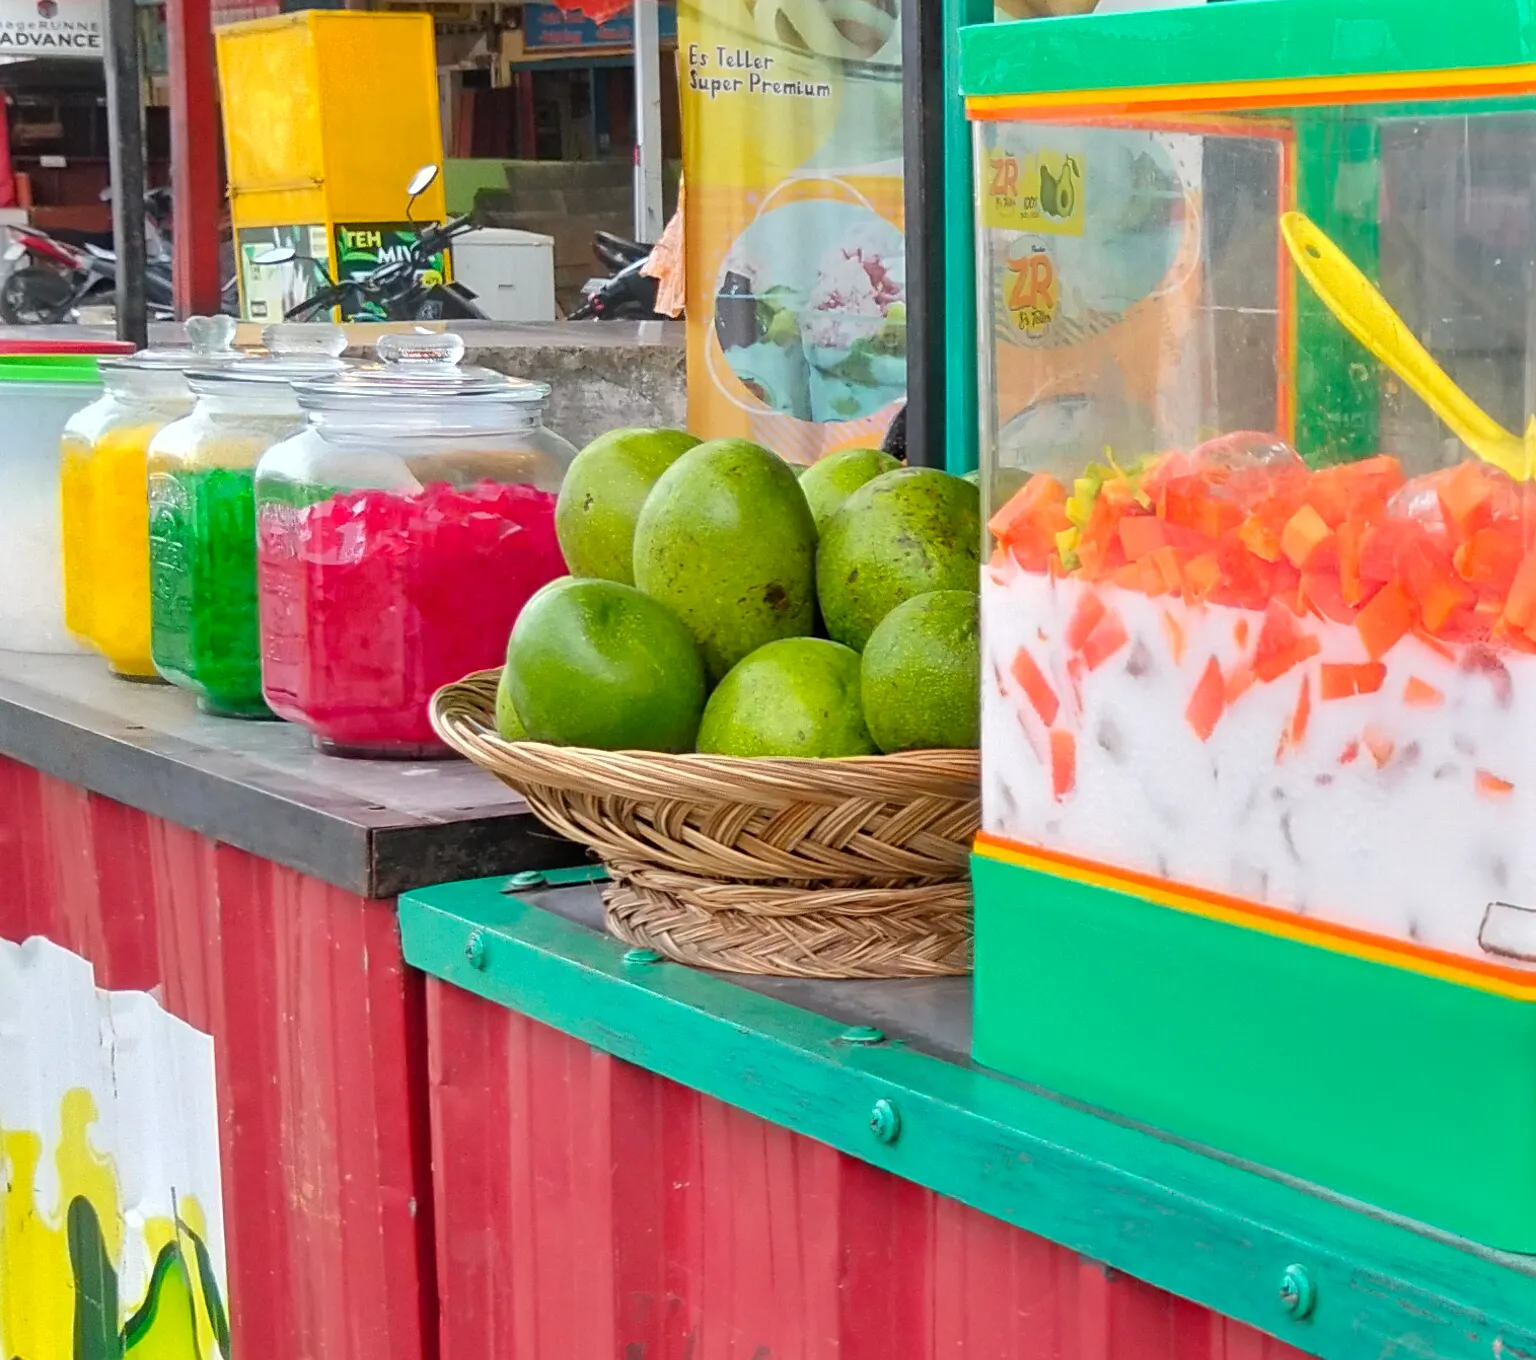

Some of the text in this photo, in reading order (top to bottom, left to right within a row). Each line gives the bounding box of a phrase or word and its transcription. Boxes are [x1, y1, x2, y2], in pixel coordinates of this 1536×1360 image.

[0, 32, 101, 49] ADVANCE
[688, 43, 775, 70] Es Teller
[688, 69, 831, 100] Super Premium
[346, 230, 382, 249] TEH
[1006, 253, 1055, 311] ZR
